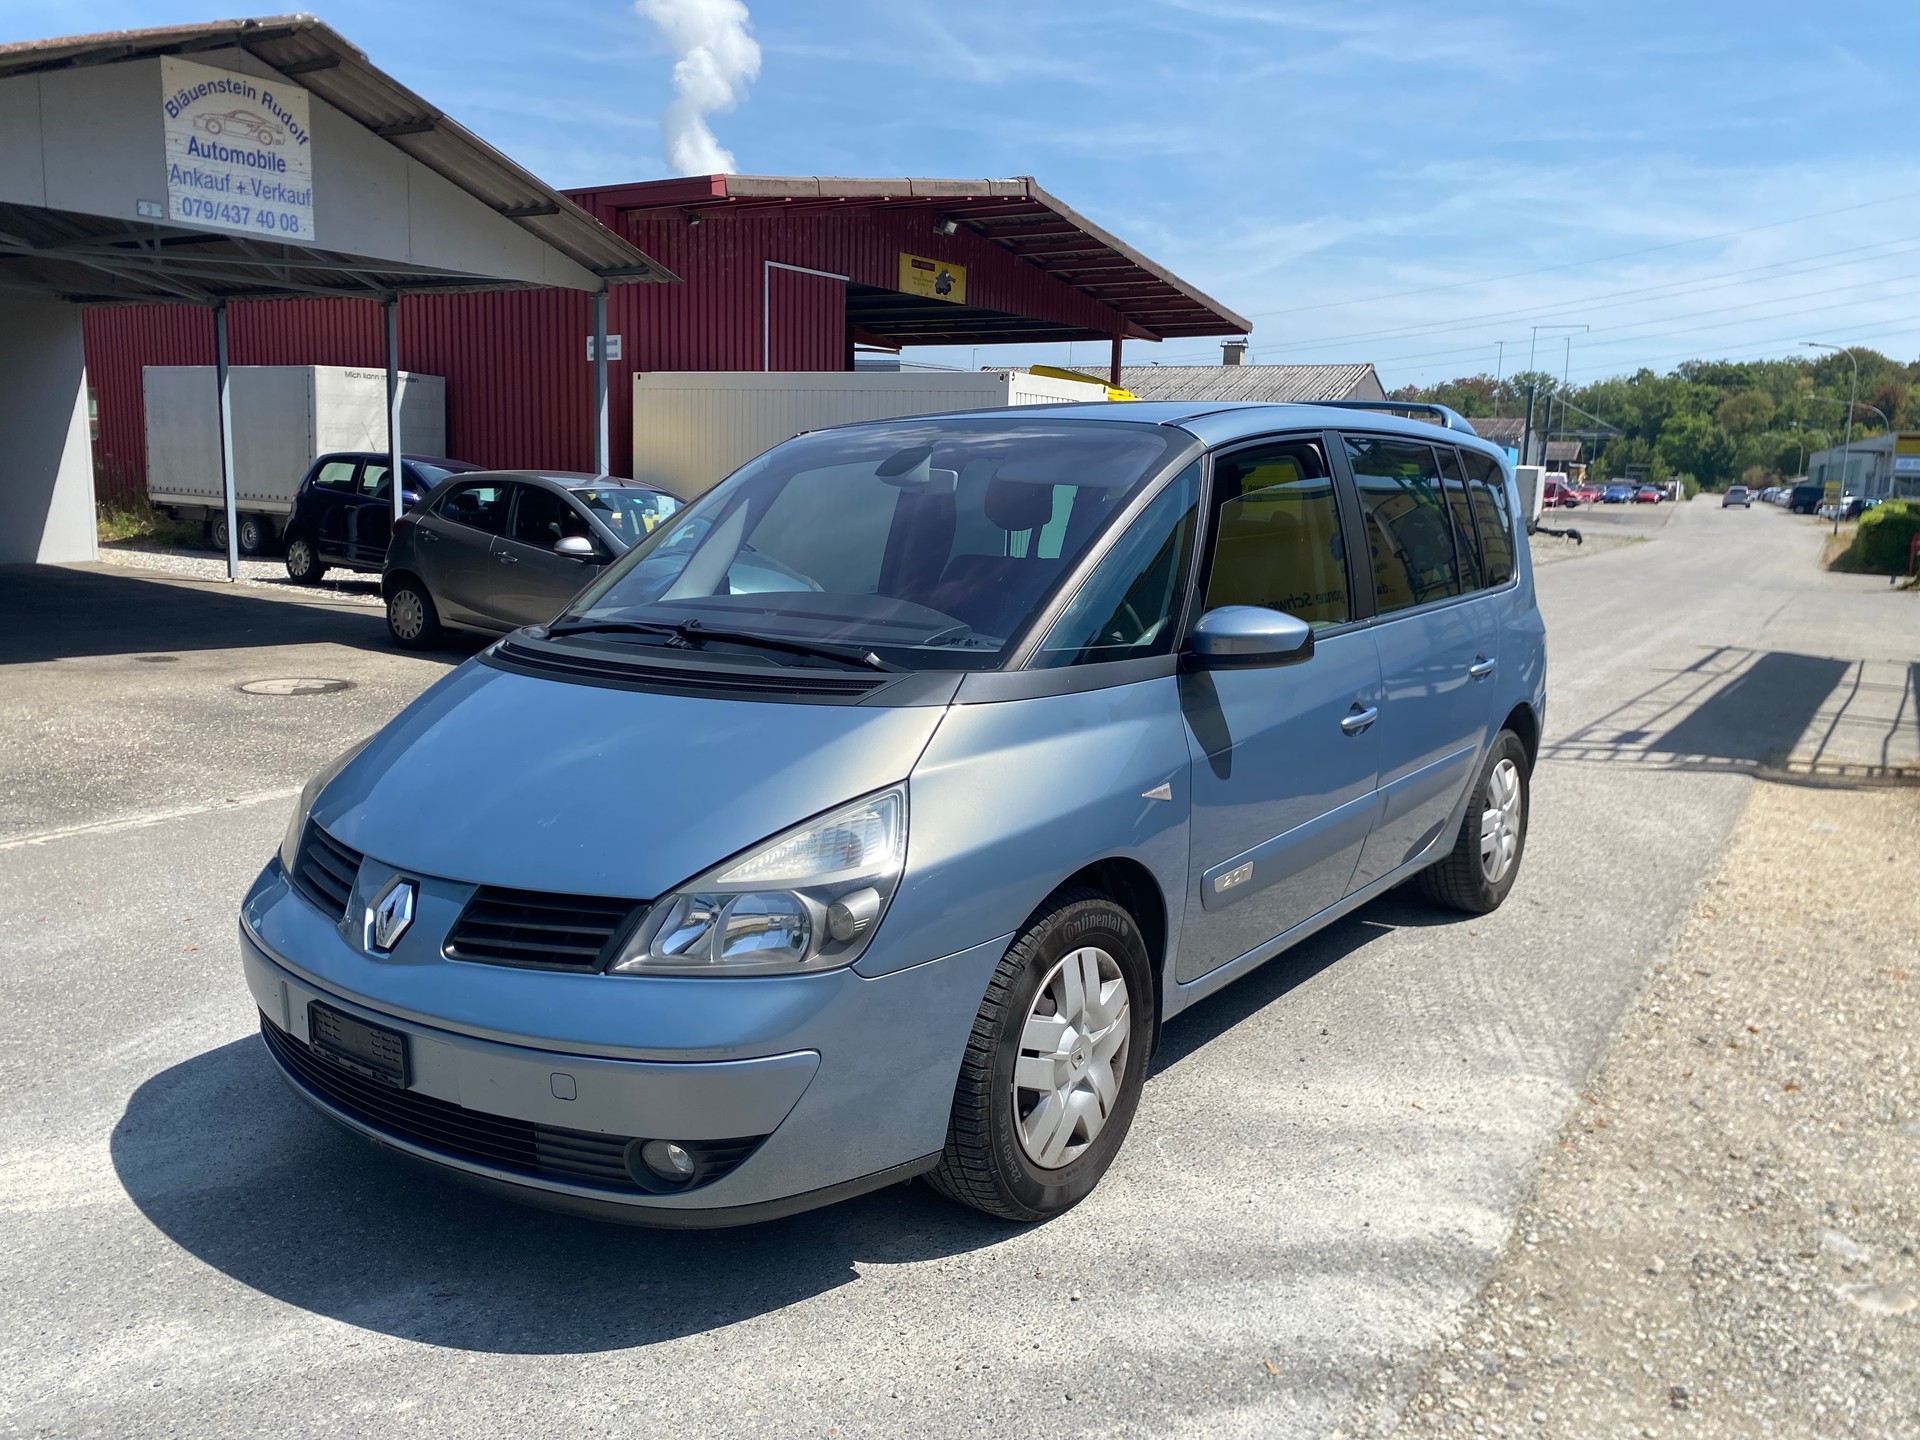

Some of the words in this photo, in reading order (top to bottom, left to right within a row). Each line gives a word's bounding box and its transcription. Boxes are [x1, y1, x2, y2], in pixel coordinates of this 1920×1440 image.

[164, 78, 257, 119] Bläuenstein
[261, 91, 310, 146] Rudolf
[187, 135, 286, 173] Automobile
[169, 163, 231, 193] Ankauf
[236, 182, 246, 195] +
[250, 178, 312, 207] Verkauf
[182, 196, 250, 225] 079/437
[256, 209, 275, 229] 40
[279, 213, 299, 233] 08
[344, 370, 362, 380] Mich
[362, 373, 380, 381] kann
[1062, 912, 1122, 944] Continental
[999, 1112, 1008, 1130] 16
[1000, 1131, 1010, 1144] R
[1003, 1143, 1023, 1184] 225/60
